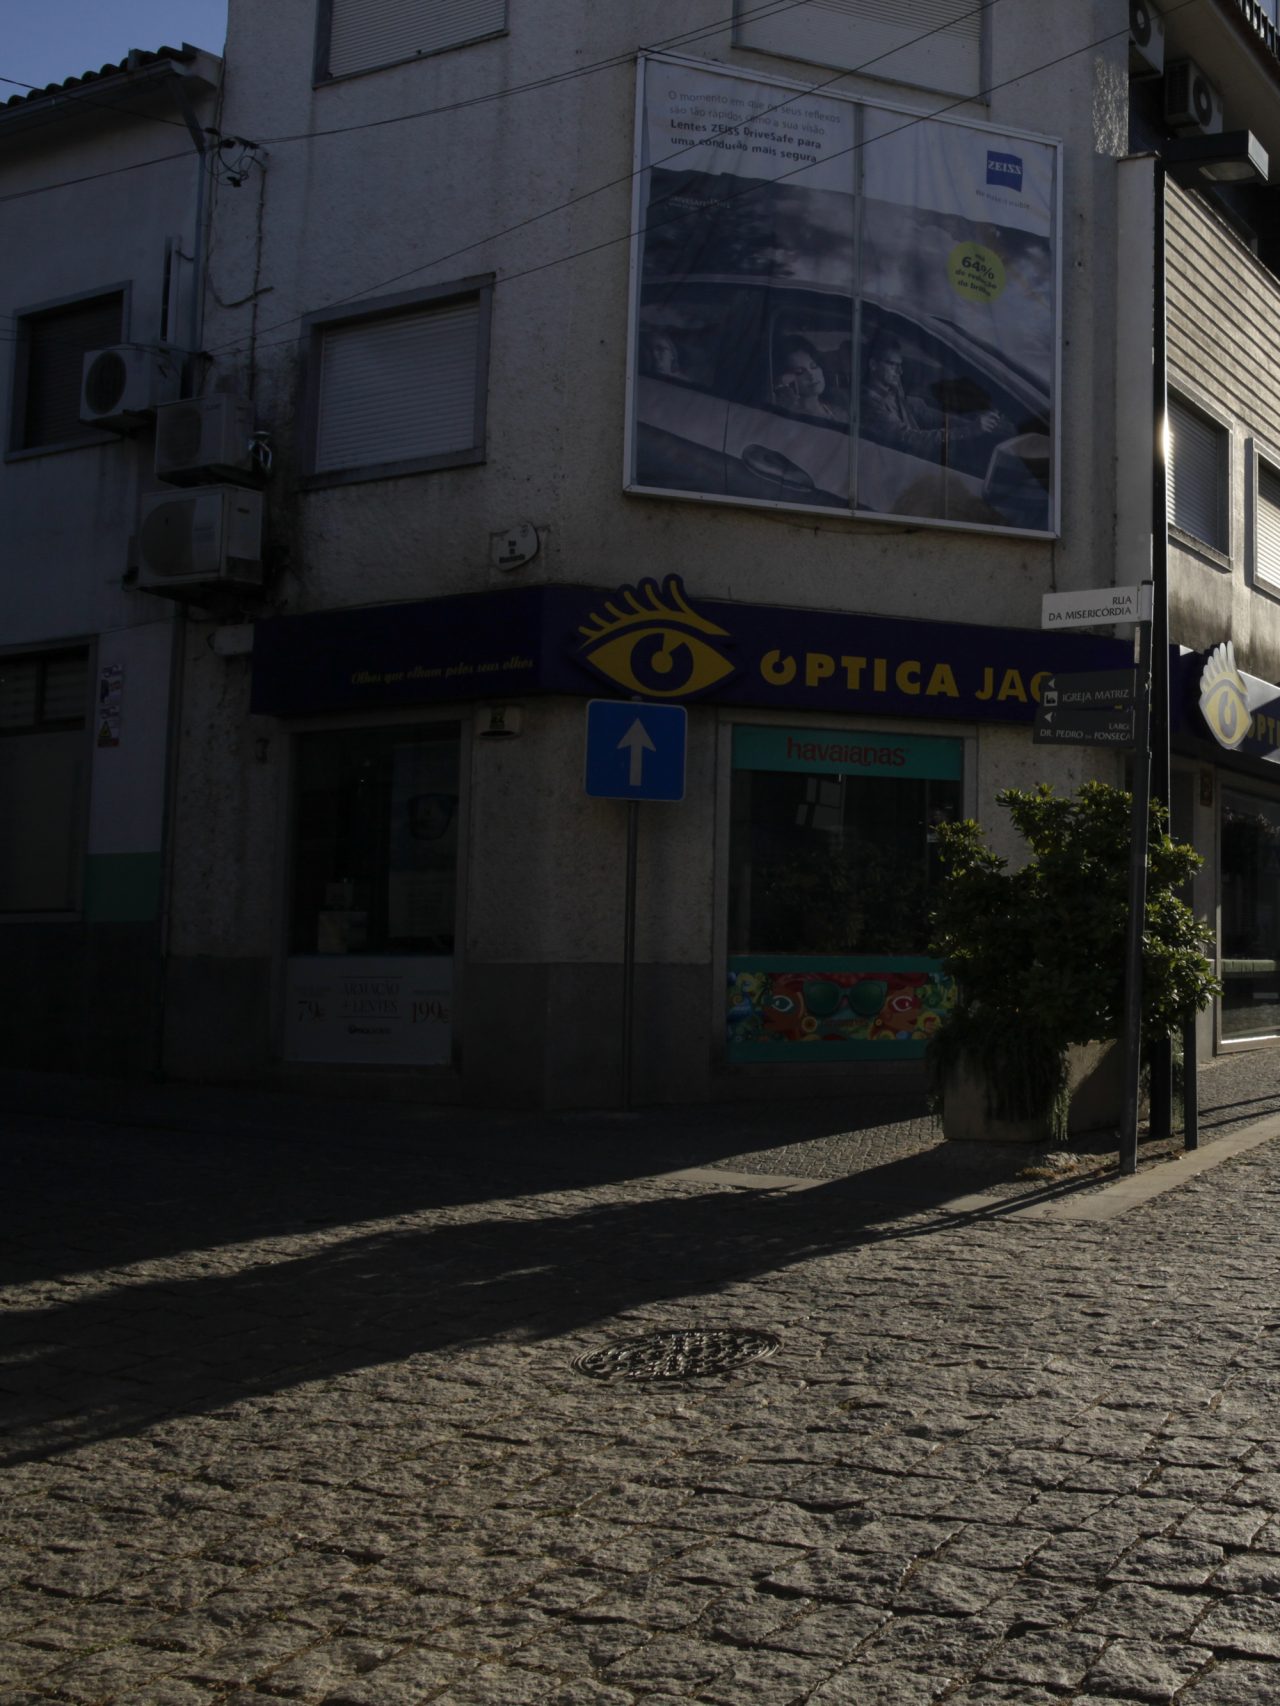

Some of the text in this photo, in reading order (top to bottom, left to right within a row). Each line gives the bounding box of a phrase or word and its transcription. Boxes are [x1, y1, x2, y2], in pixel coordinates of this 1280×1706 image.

[668, 90, 677, 100] O
[680, 94, 728, 105] momento
[730, 98, 745, 107] em
[781, 106, 802, 116] seus
[805, 109, 841, 124] reflexos
[669, 106, 687, 115] são
[690, 106, 706, 118] tão
[782, 120, 798, 130] sua
[670, 118, 822, 150] Lentes ZEISS DriveSafe para
[671, 137, 695, 147] uma
[751, 145, 777, 156] mais
[780, 151, 817, 163] segura
[987, 160, 1022, 175] ZEISS
[961, 256, 995, 280] 64%
[1112, 596, 1133, 605] RUA
[1049, 605, 1132, 622] DA MISERICÓRDIA
[1062, 689, 1129, 702] IGREJA MATRIZ
[1056, 729, 1084, 739] PEDRO
[1094, 731, 1131, 741] FONSECA
[786, 735, 906, 766] havaianas
